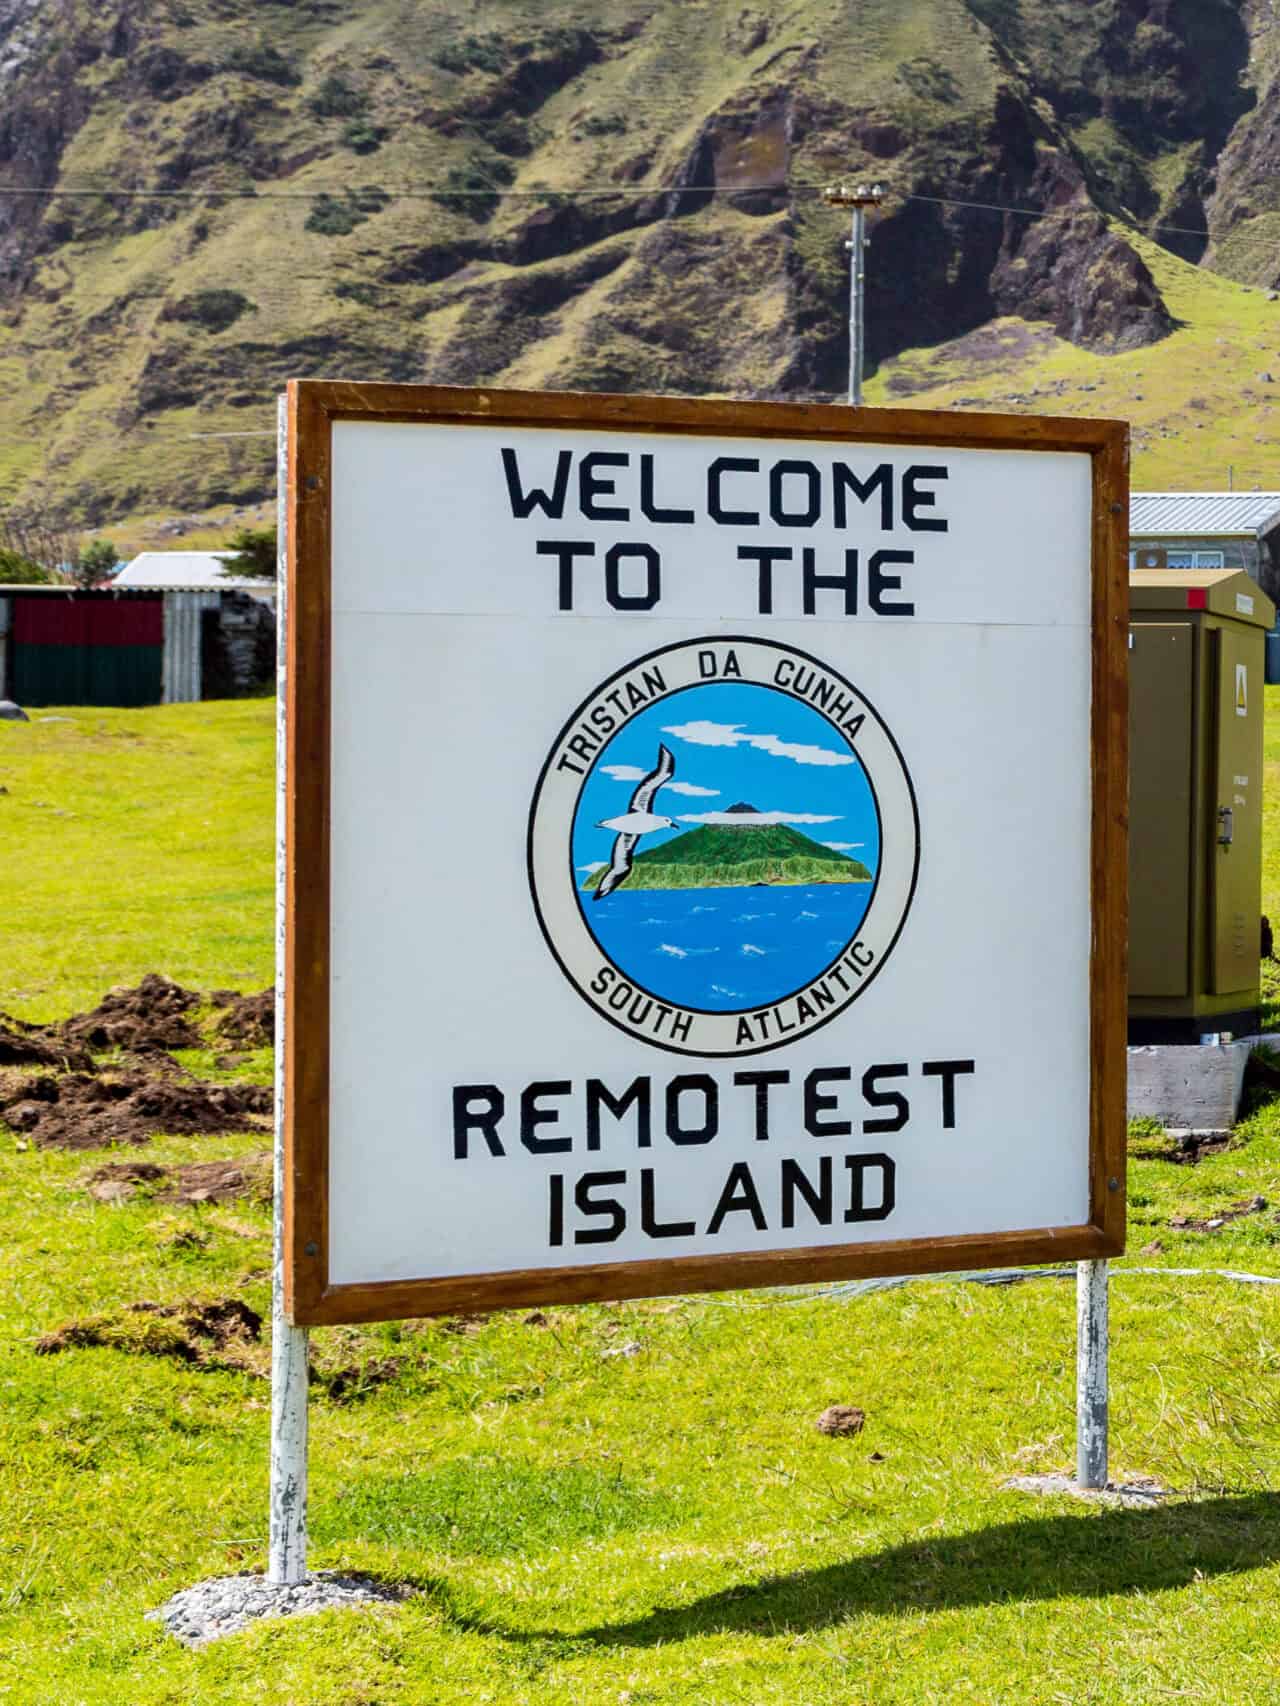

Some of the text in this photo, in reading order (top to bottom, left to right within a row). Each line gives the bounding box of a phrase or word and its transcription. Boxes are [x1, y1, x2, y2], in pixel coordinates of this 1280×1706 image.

[501, 447, 949, 532] WELCOME
[537, 540, 915, 616] TO THE
[556, 648, 866, 777] TRISTAN DA CUNHA
[589, 940, 875, 1046] SOUTH ATLANTIC
[452, 1059, 974, 1160] REMOTEST
[549, 1152, 896, 1247] ISLAND
